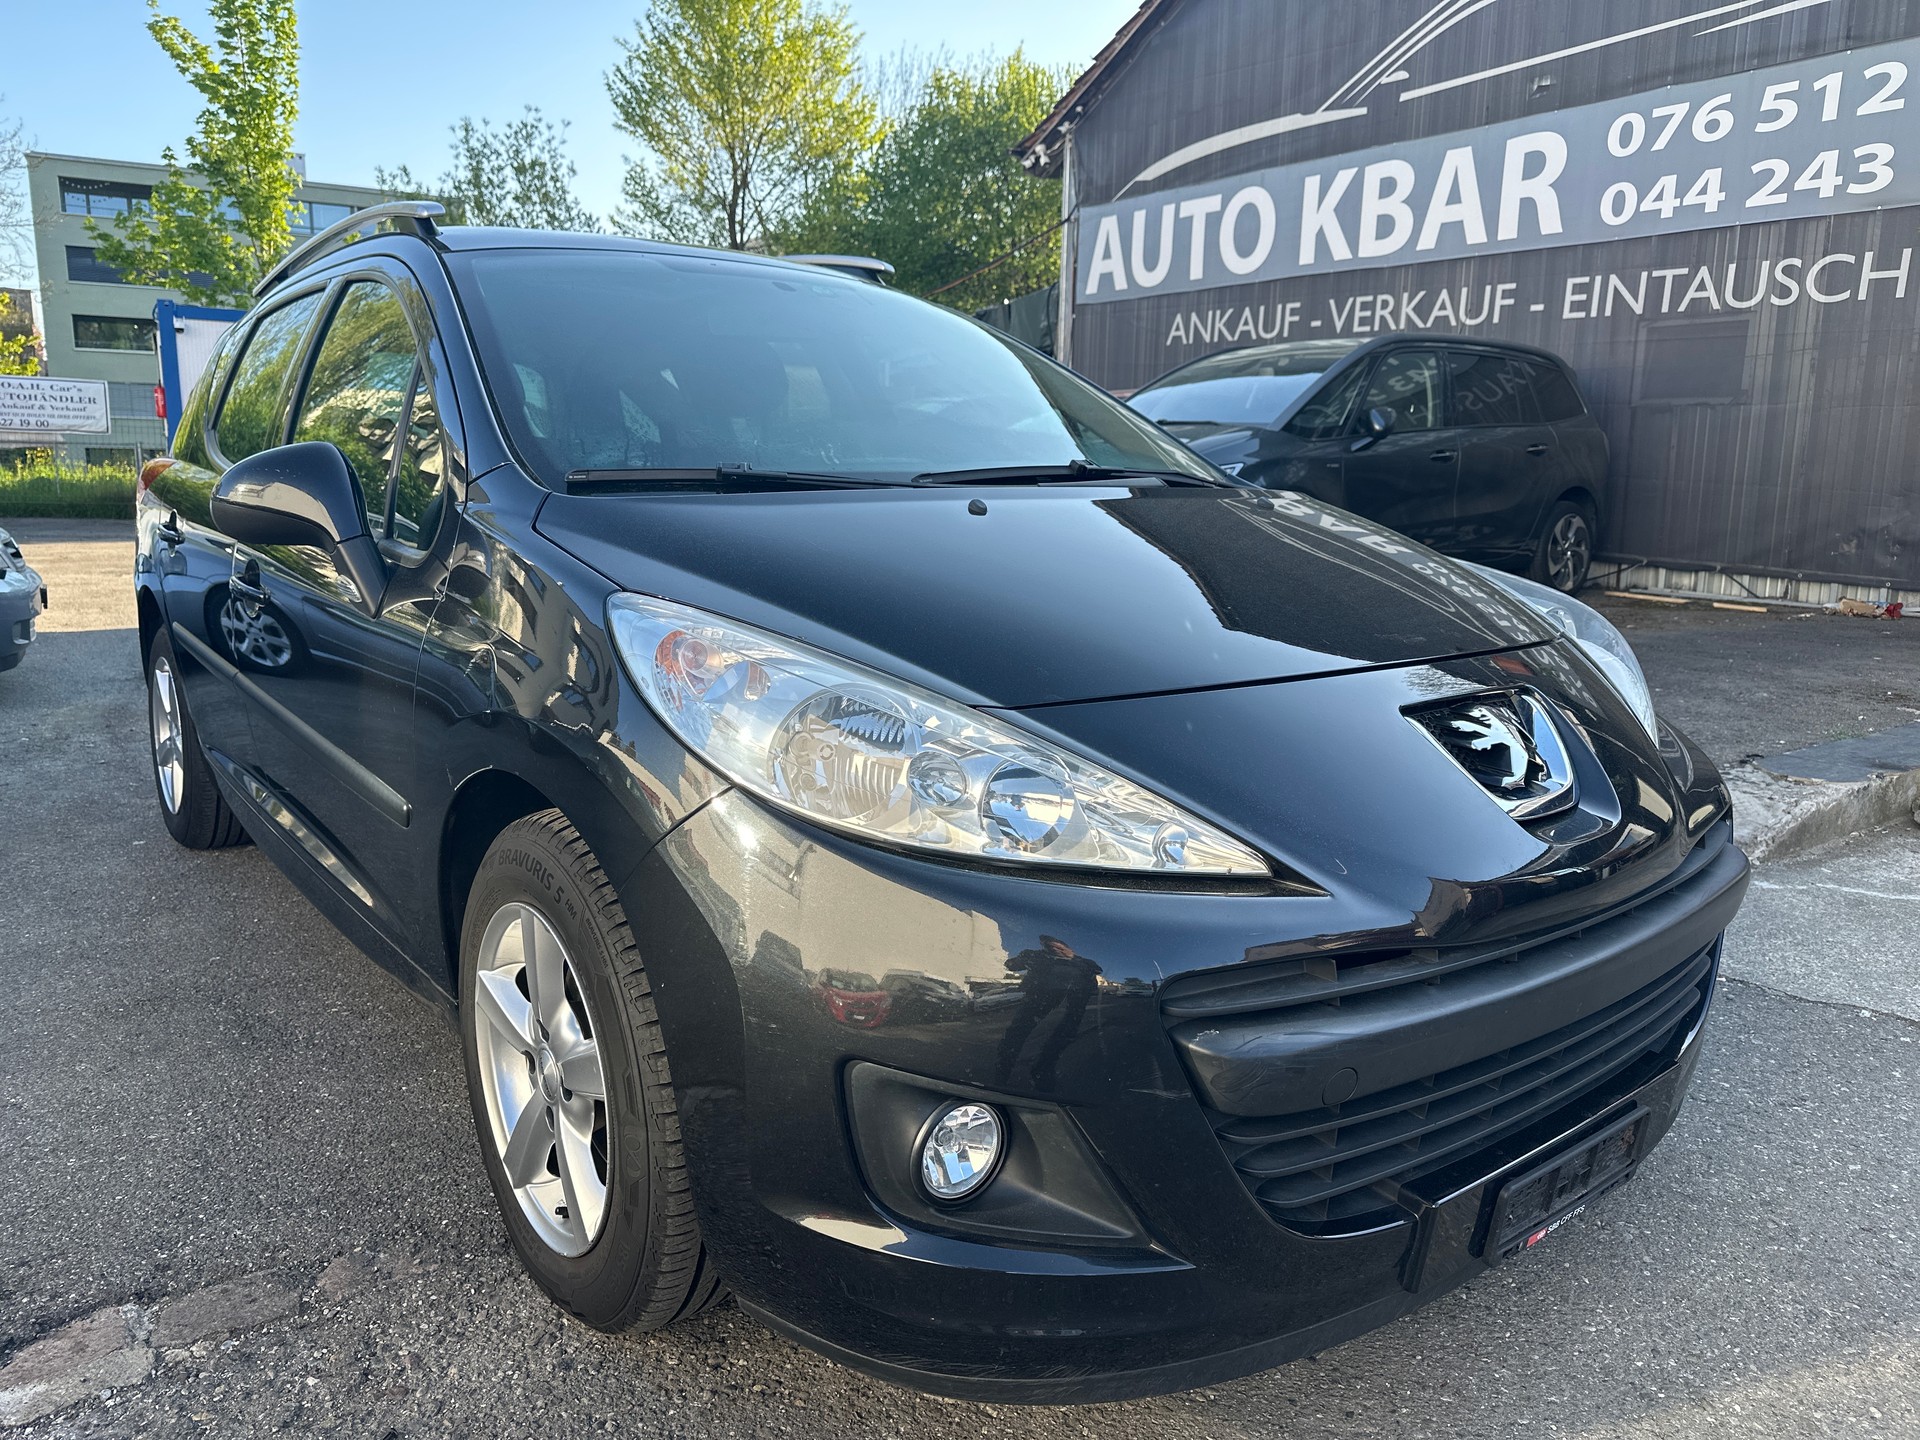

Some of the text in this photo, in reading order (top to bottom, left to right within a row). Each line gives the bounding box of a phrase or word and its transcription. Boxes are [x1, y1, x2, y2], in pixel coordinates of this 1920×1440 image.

[1606, 60, 1909, 158] 076 512
[1085, 130, 1568, 296] AUTO KBAR
[1599, 142, 1896, 227] 044 243
[1166, 302, 1301, 347] ANKAUF
[1328, 282, 1517, 334] VERKAUF
[1561, 247, 1913, 321] EINTAUSCH
[1, 402, 36, 410] Ankauf
[50, 404, 88, 412] Verkauf
[19, 418, 31, 428] 19
[35, 419, 50, 428] 00
[498, 848, 555, 891] BRAVURIS
[553, 885, 565, 905] 5
